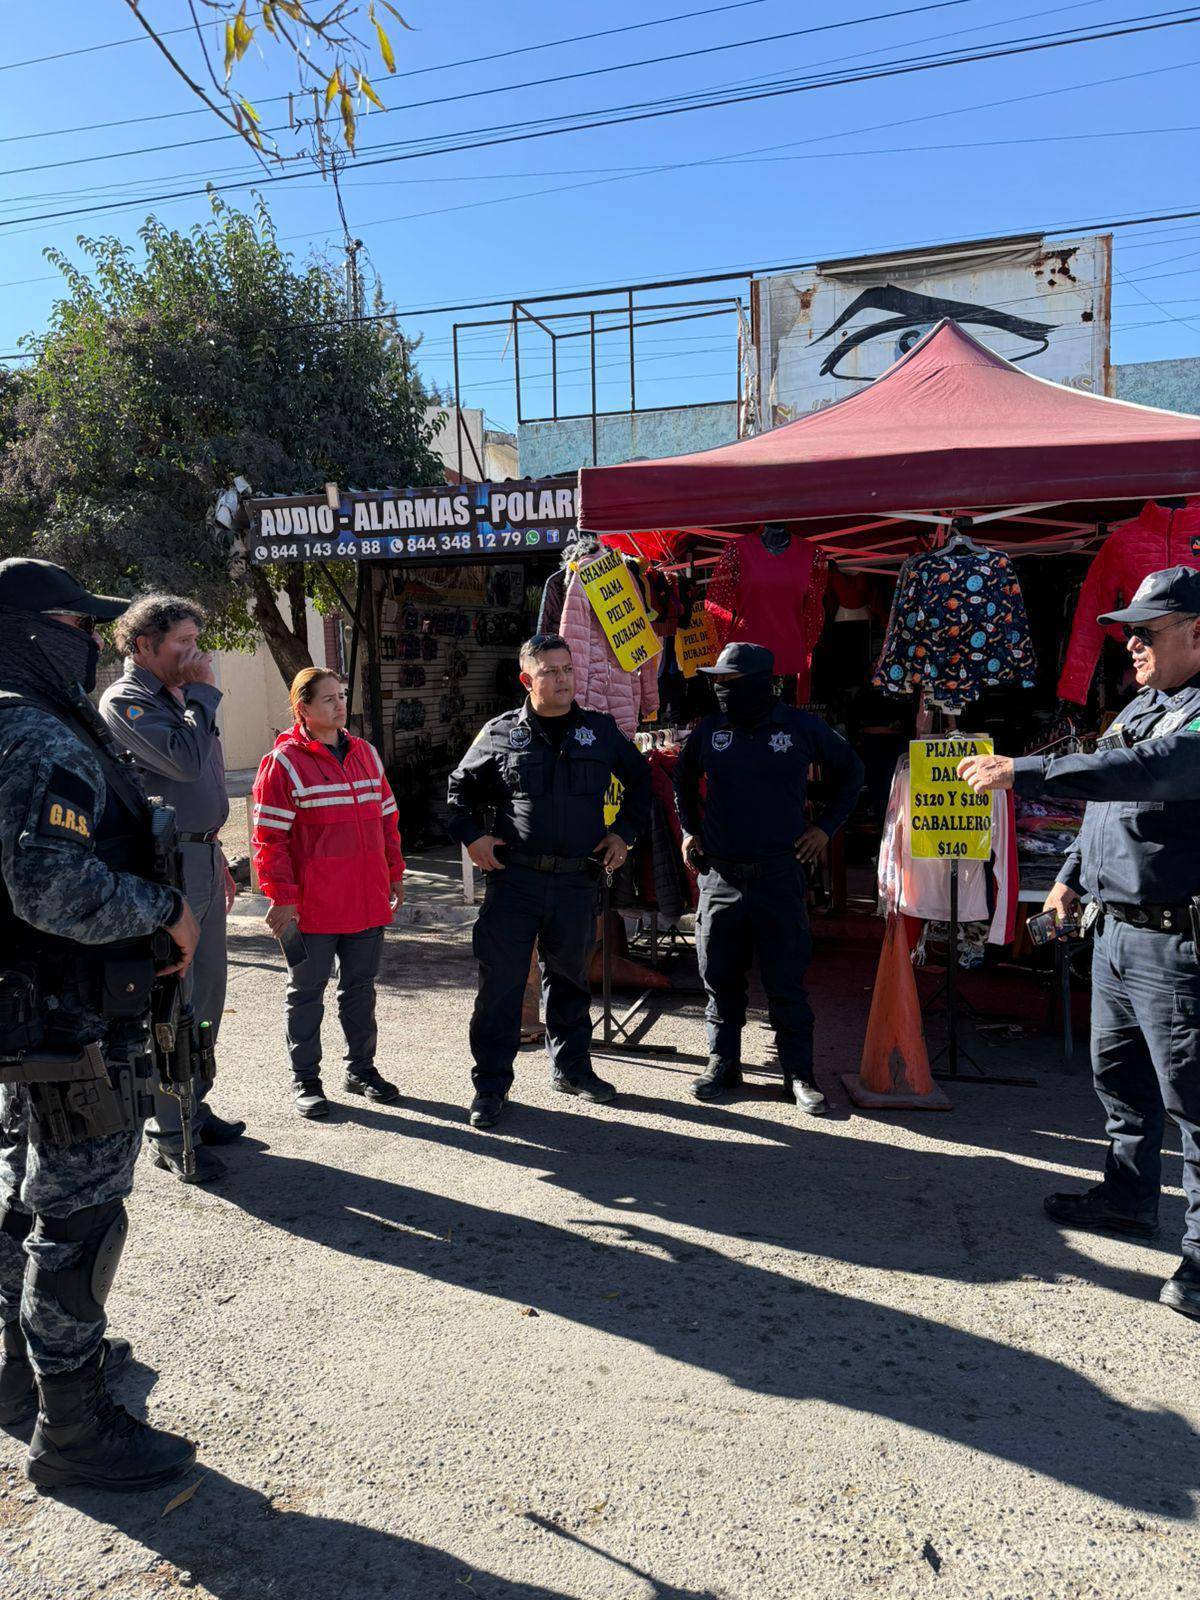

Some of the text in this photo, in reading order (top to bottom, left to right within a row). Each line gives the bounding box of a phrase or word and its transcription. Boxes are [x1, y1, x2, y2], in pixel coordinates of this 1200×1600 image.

[261, 505, 335, 537] AUDIO
[354, 495, 471, 532] ALARMAS
[271, 544, 298, 559] 844
[304, 543, 332, 557] 143
[337, 542, 357, 555] 66
[361, 540, 381, 555] 88
[407, 537, 436, 552] 844
[441, 535, 471, 550] 348
[477, 534, 496, 548] 12
[501, 531, 522, 546] 79
[580, 550, 623, 585] CHAMARRA
[600, 578, 624, 601] DAMA
[606, 597, 635, 624] PIEL DE
[612, 616, 645, 649] DURAZNO
[631, 645, 648, 664] $495
[926, 741, 978, 757] PIJAMA
[915, 792, 944, 808] $120
[947, 790, 958, 806] Y
[50, 803, 91, 838] G.R.S.
[911, 815, 991, 831] CABALLERO
[938, 840, 968, 857] $140
